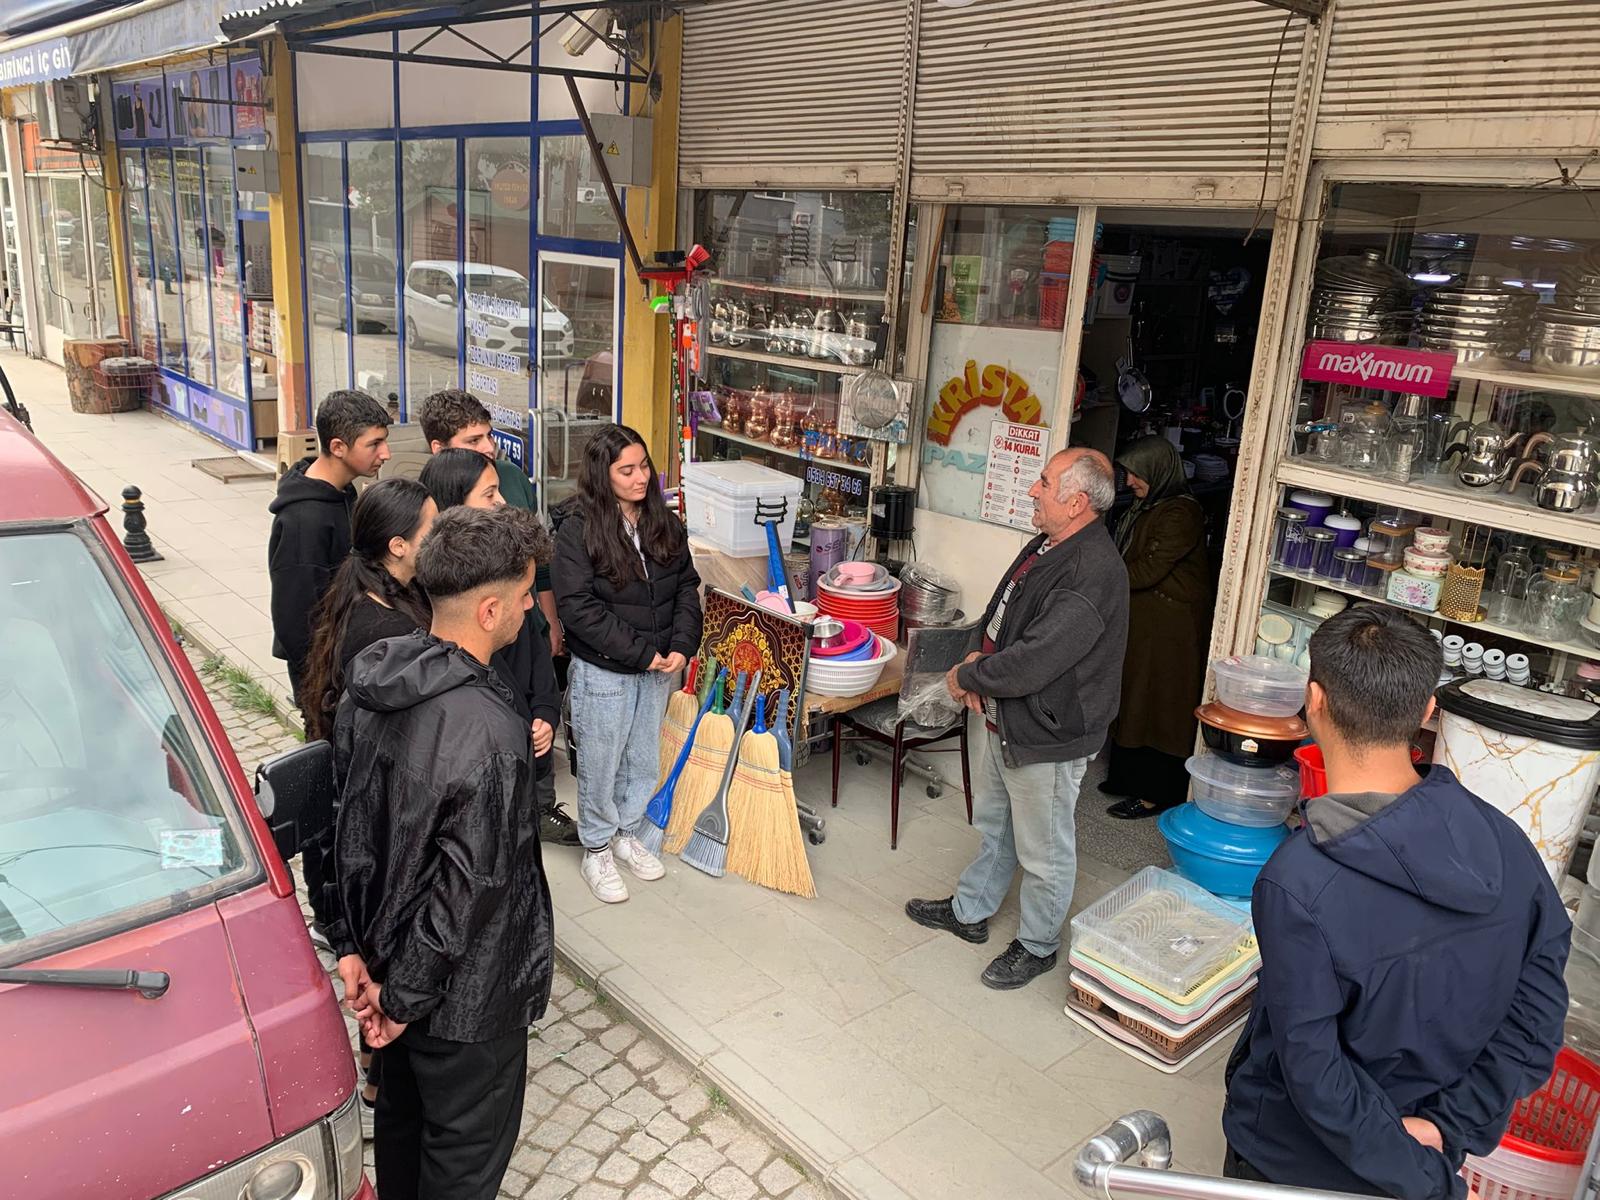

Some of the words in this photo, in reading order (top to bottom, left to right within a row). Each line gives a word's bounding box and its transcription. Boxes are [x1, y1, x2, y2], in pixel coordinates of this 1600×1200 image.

[927, 359, 1049, 446] KRİSTA
[512, 442, 521, 460] 53
[1004, 440, 1013, 452] 14
[1013, 443, 1041, 457] KURAL
